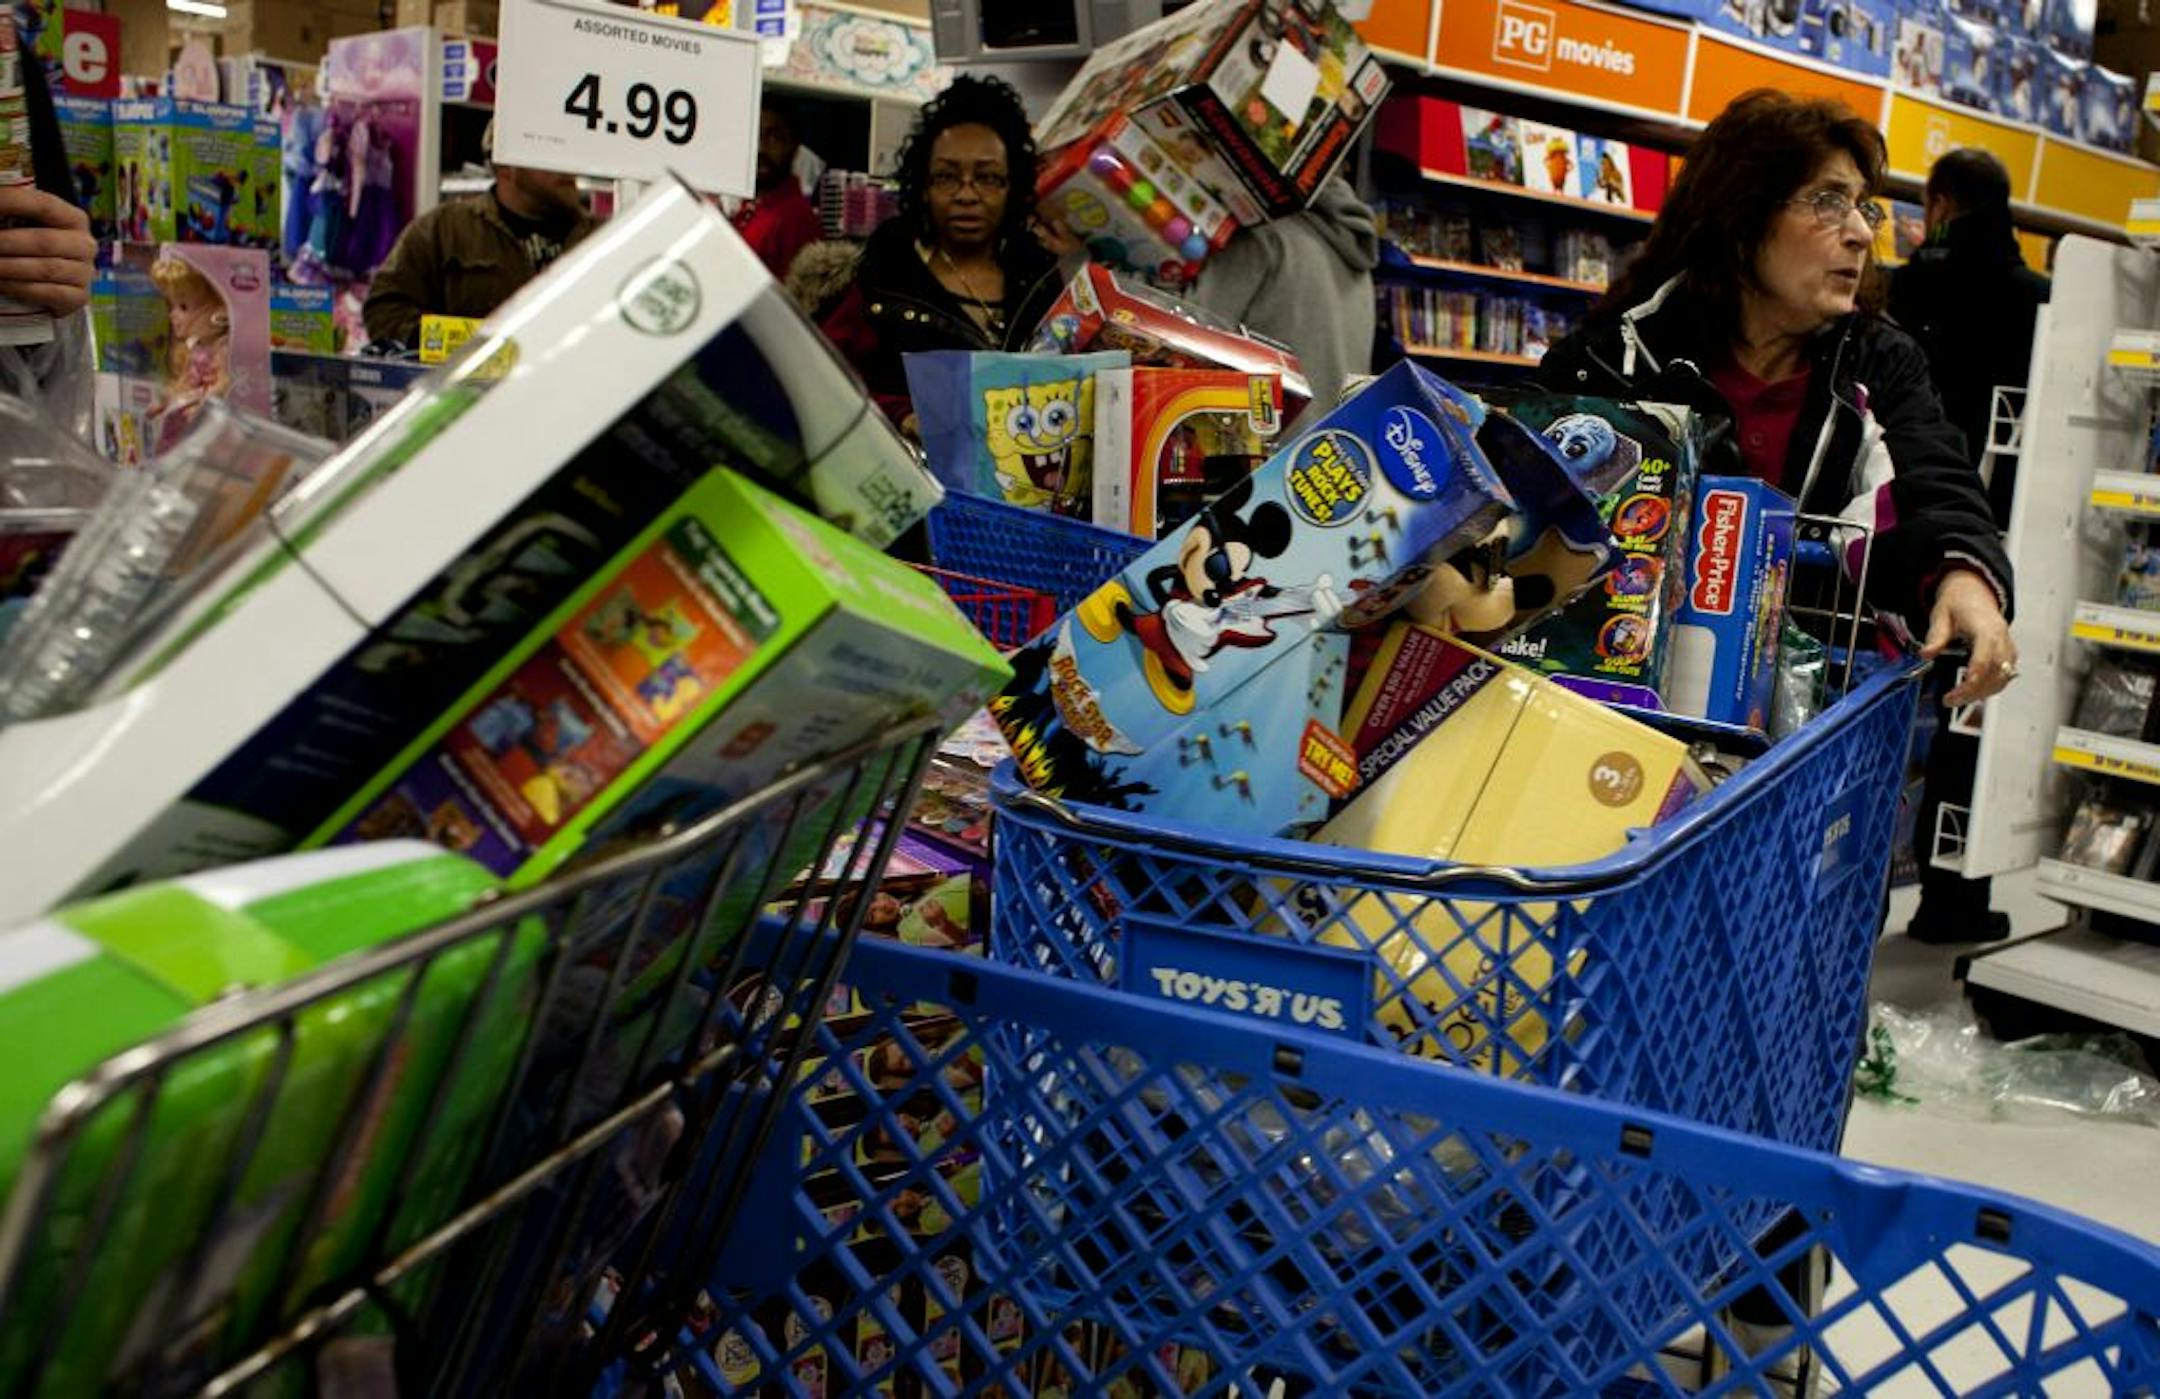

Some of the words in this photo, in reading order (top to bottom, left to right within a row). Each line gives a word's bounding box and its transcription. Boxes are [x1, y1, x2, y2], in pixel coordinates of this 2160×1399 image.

[574, 18, 649, 44] ASSORTED
[651, 34, 702, 54] MOVIES
[1500, 14, 1547, 55] PG
[1556, 37, 1635, 75] movies
[564, 72, 698, 146] 4.99
[1312, 440, 1362, 501] PLAYS
[1384, 408, 1437, 493] Disney
[1640, 457, 1671, 474] 40+
[1291, 470, 1333, 523] TUNES!
[1307, 464, 1340, 506] ROCK
[1705, 499, 1738, 607] Fisher-Price
[1052, 656, 1090, 703] ROCK
[1083, 699, 1115, 749] STAR
[1359, 727, 1416, 778] SPECIAL
[1409, 687, 1461, 732] VALUE
[1451, 657, 1497, 697] PACK
[1305, 737, 1333, 769] TRY
[1593, 766, 1621, 788] 3
[1151, 967, 1249, 1011] TOYS
